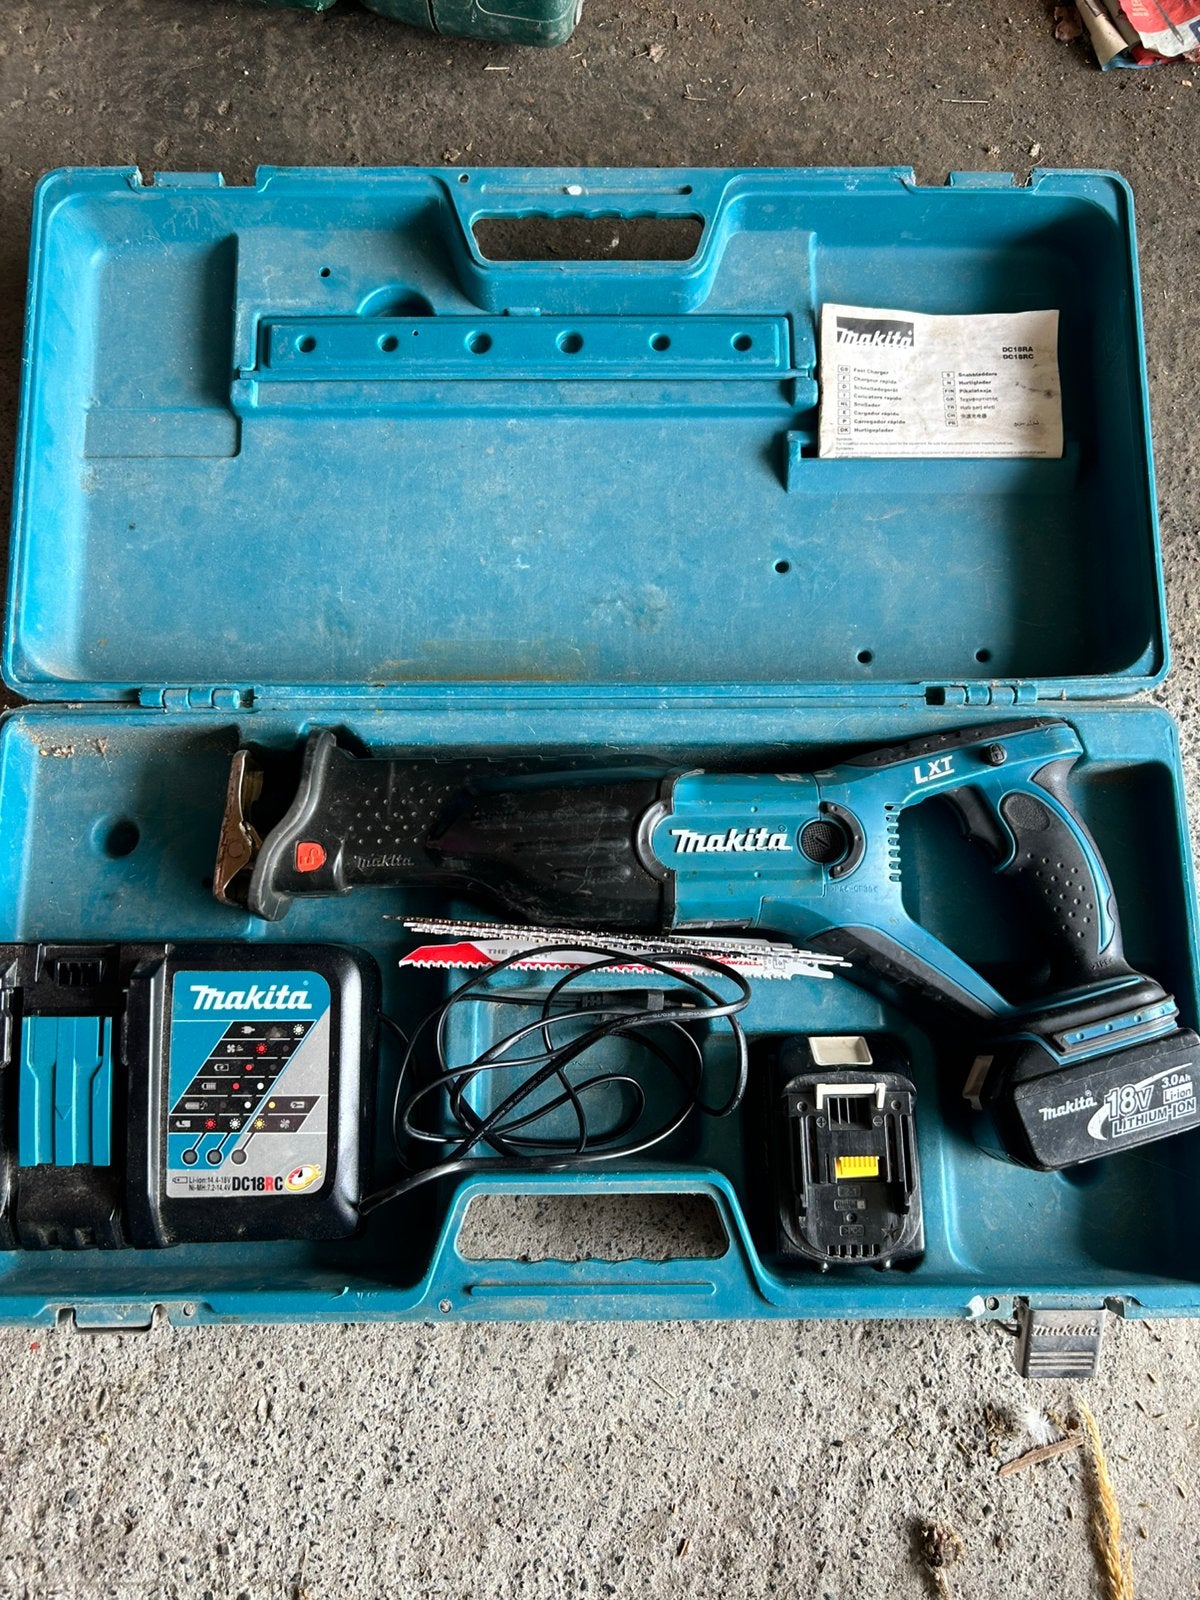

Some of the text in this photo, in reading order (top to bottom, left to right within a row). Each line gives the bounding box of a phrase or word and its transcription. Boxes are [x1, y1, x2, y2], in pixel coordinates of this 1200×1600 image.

[913, 755, 954, 784] LXT
[1104, 1083, 1154, 1122] 18V
[1112, 1097, 1196, 1137] LITHIUM-ION
[232, 1176, 284, 1191] DC18RC
